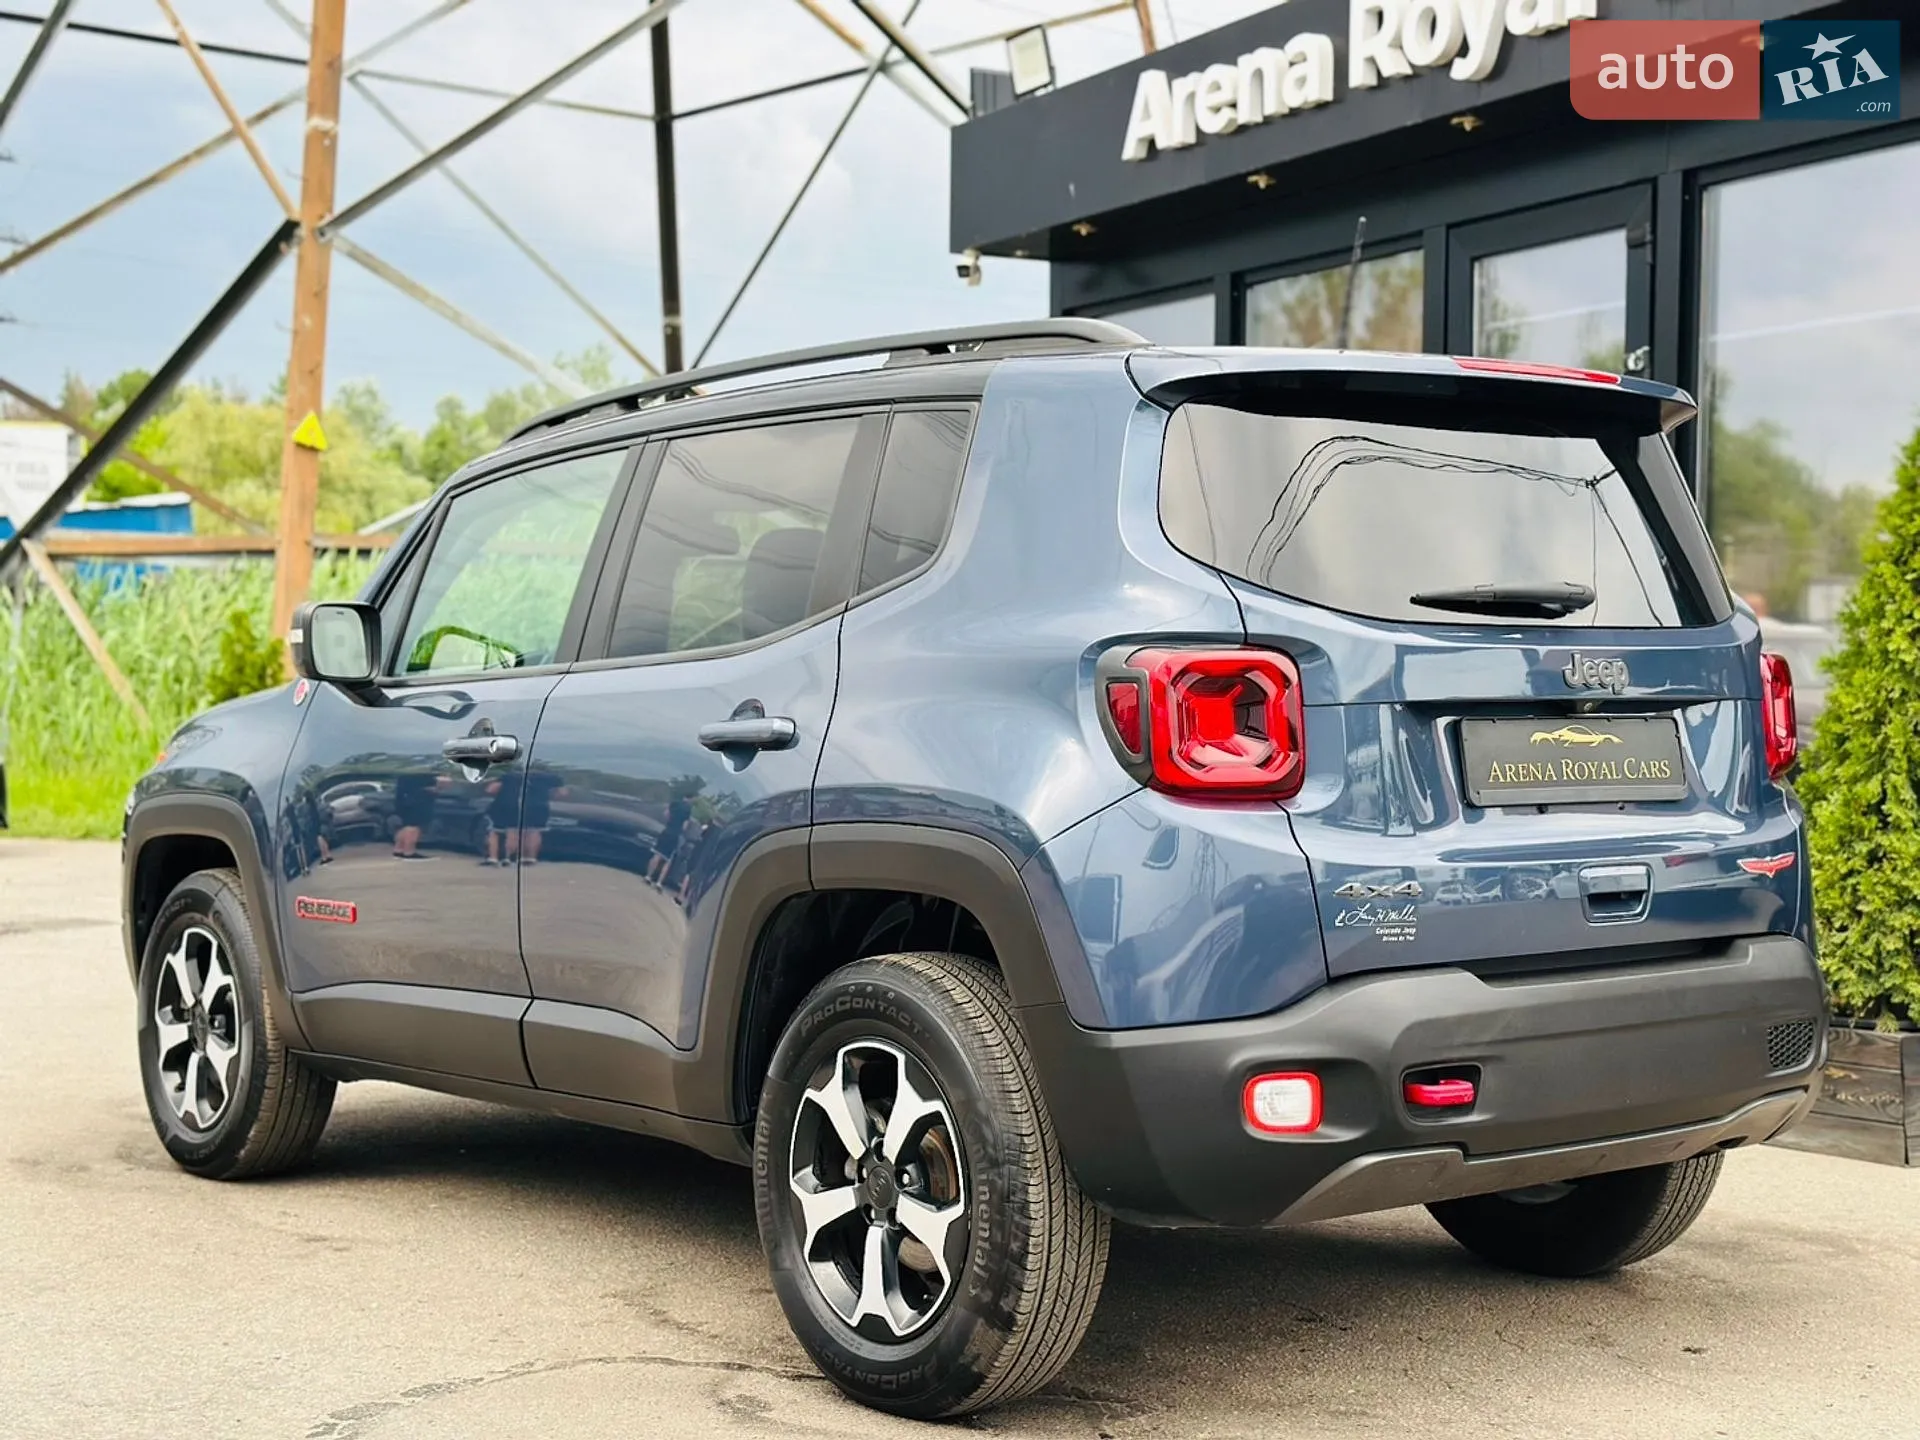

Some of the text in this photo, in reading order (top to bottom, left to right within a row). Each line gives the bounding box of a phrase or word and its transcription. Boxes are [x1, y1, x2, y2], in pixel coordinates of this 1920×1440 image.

[1121, 0, 1598, 161] Arena Roy
[1562, 651, 1629, 695] Jeep
[1488, 757, 1671, 783] ARENA ROYAL CARS
